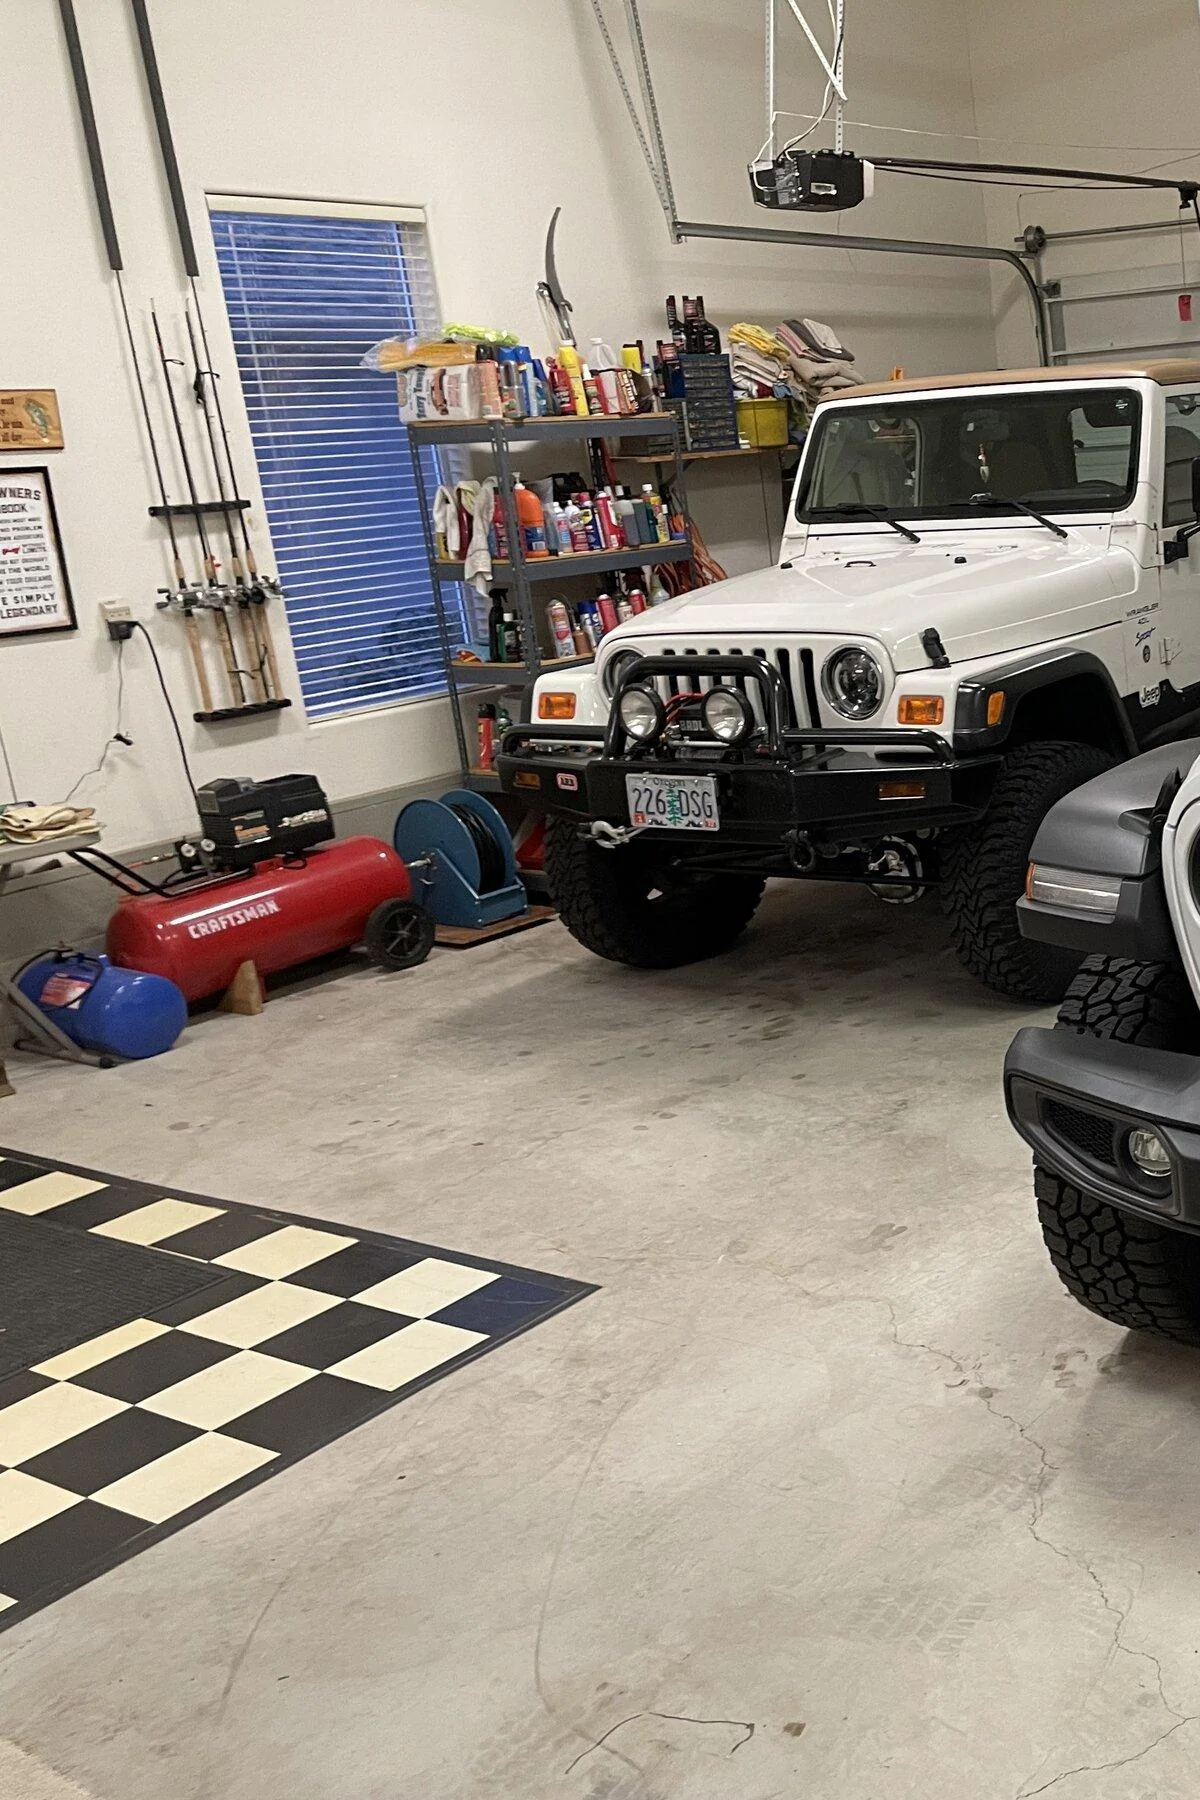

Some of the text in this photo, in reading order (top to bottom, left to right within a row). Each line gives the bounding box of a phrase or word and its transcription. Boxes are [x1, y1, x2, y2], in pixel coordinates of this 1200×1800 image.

[0, 504, 28, 514] BOOK
[13, 593, 55, 604] SIMPLY
[0, 604, 57, 619] LEGENDARY
[1141, 687, 1159, 703] Jeep
[632, 788, 713, 818] 226 DSG
[188, 900, 281, 939] CRAFTSMAN
